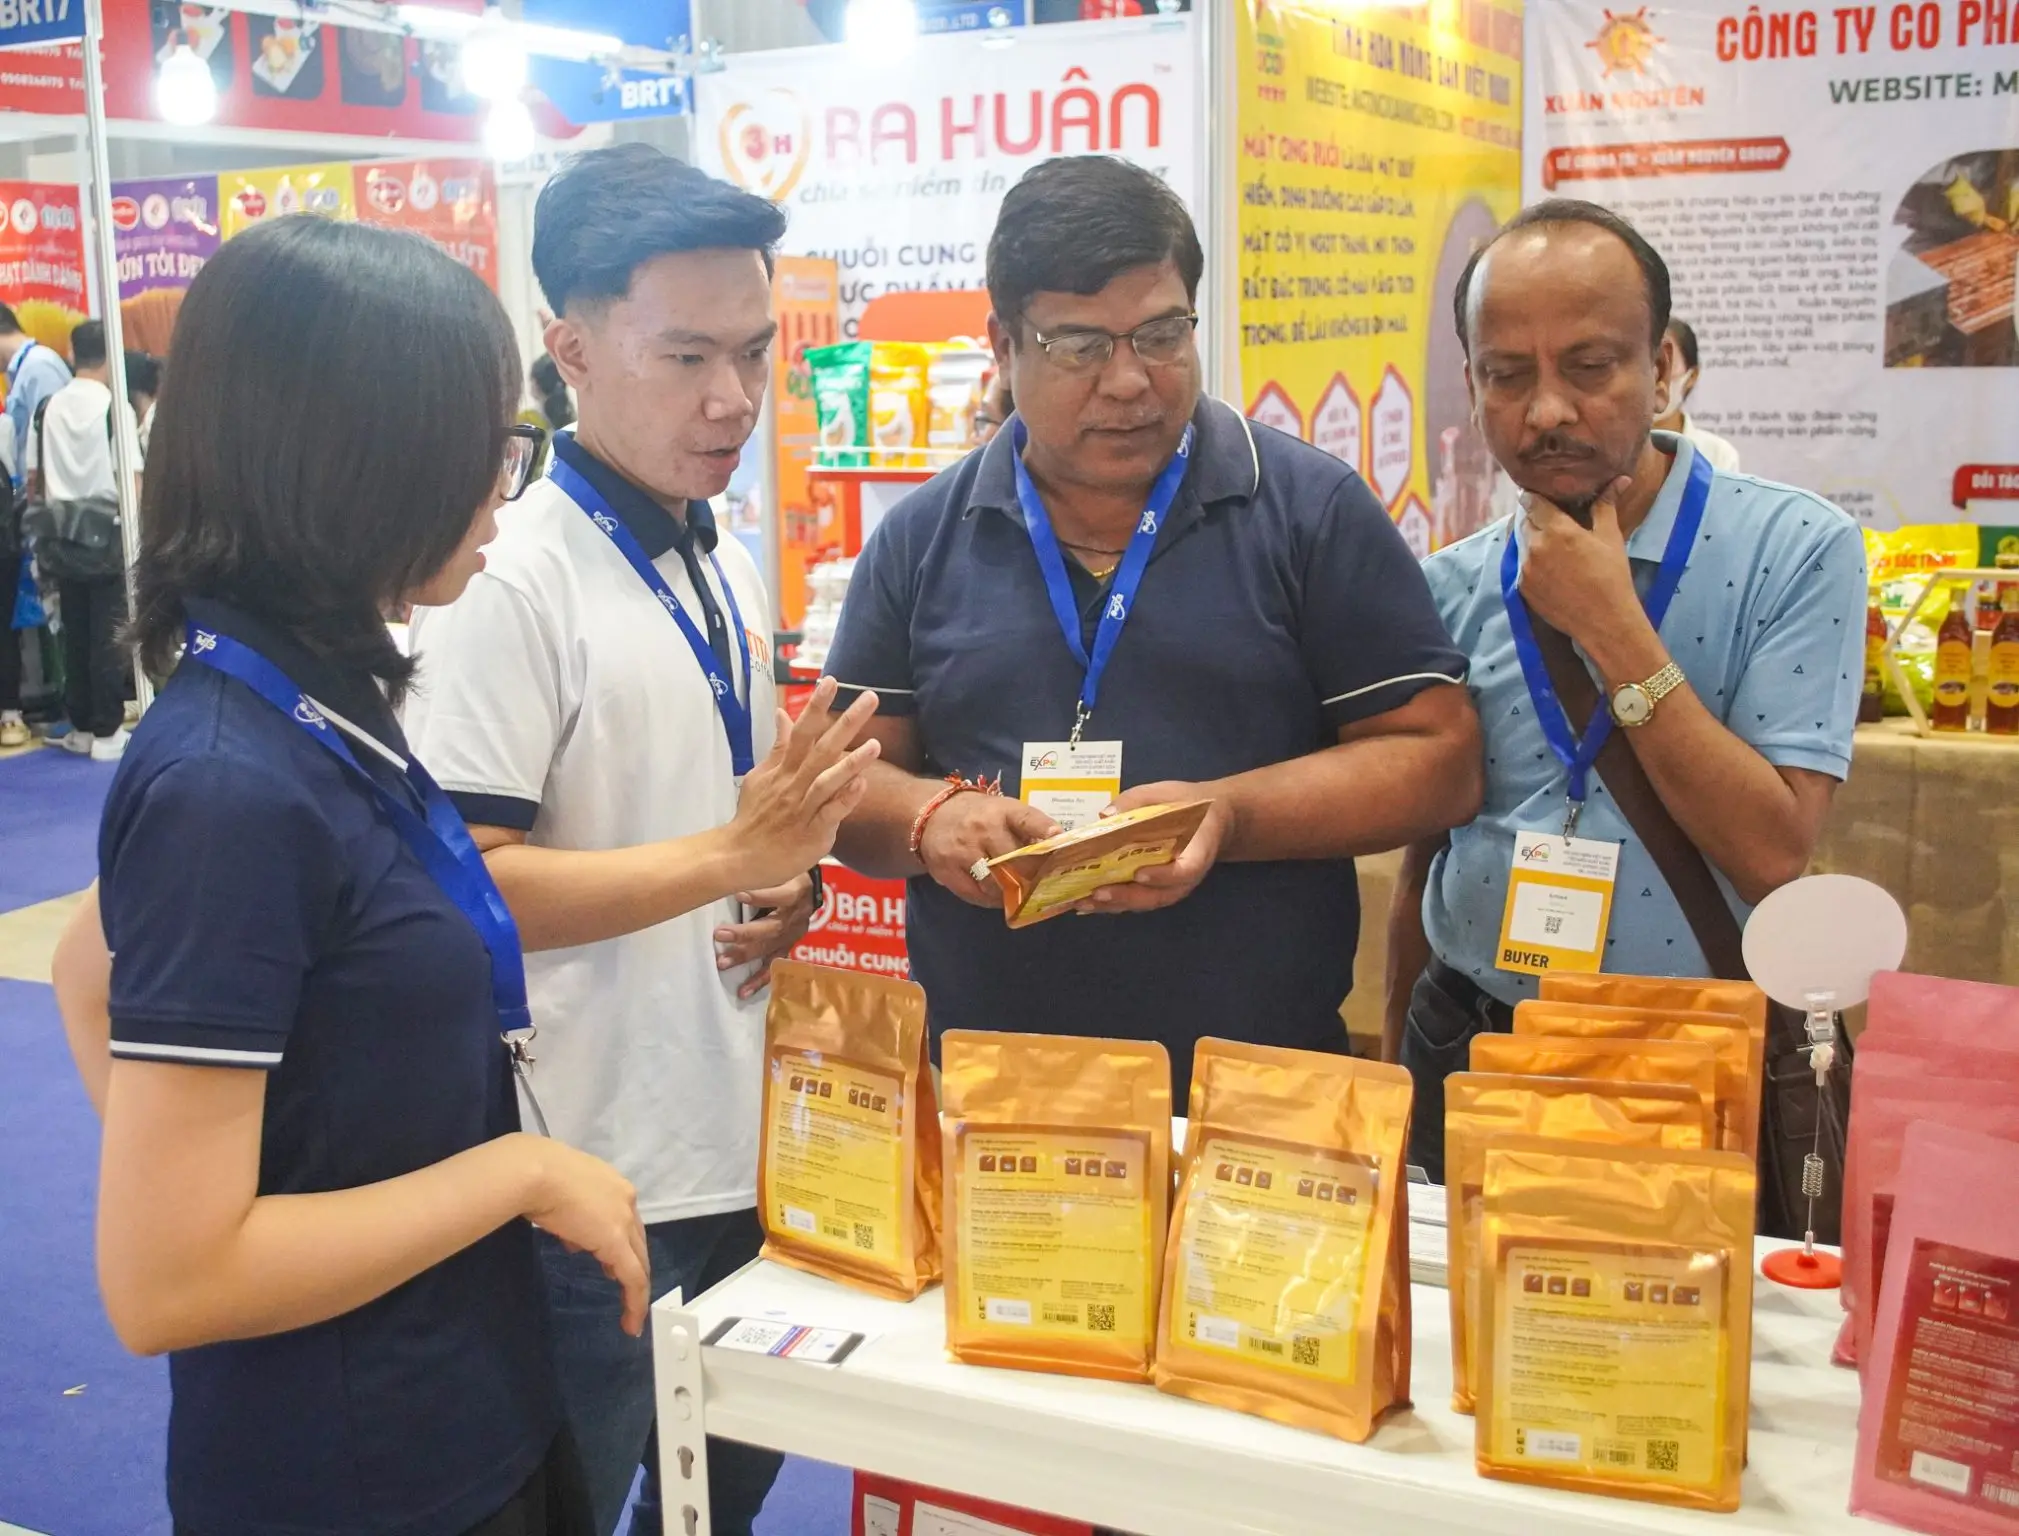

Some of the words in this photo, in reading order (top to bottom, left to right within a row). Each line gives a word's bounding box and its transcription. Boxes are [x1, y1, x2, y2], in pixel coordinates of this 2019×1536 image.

[1716, 5, 1818, 62] CÔNG
[1833, 6, 1877, 54] TY
[1829, 72, 1983, 104] WEBSITE:
[940, 65, 1161, 162] HUÂN
[898, 242, 976, 267] CUNG
[836, 892, 878, 924] BA
[794, 942, 857, 967] CHUỖI
[1502, 948, 1550, 969] BUYER
